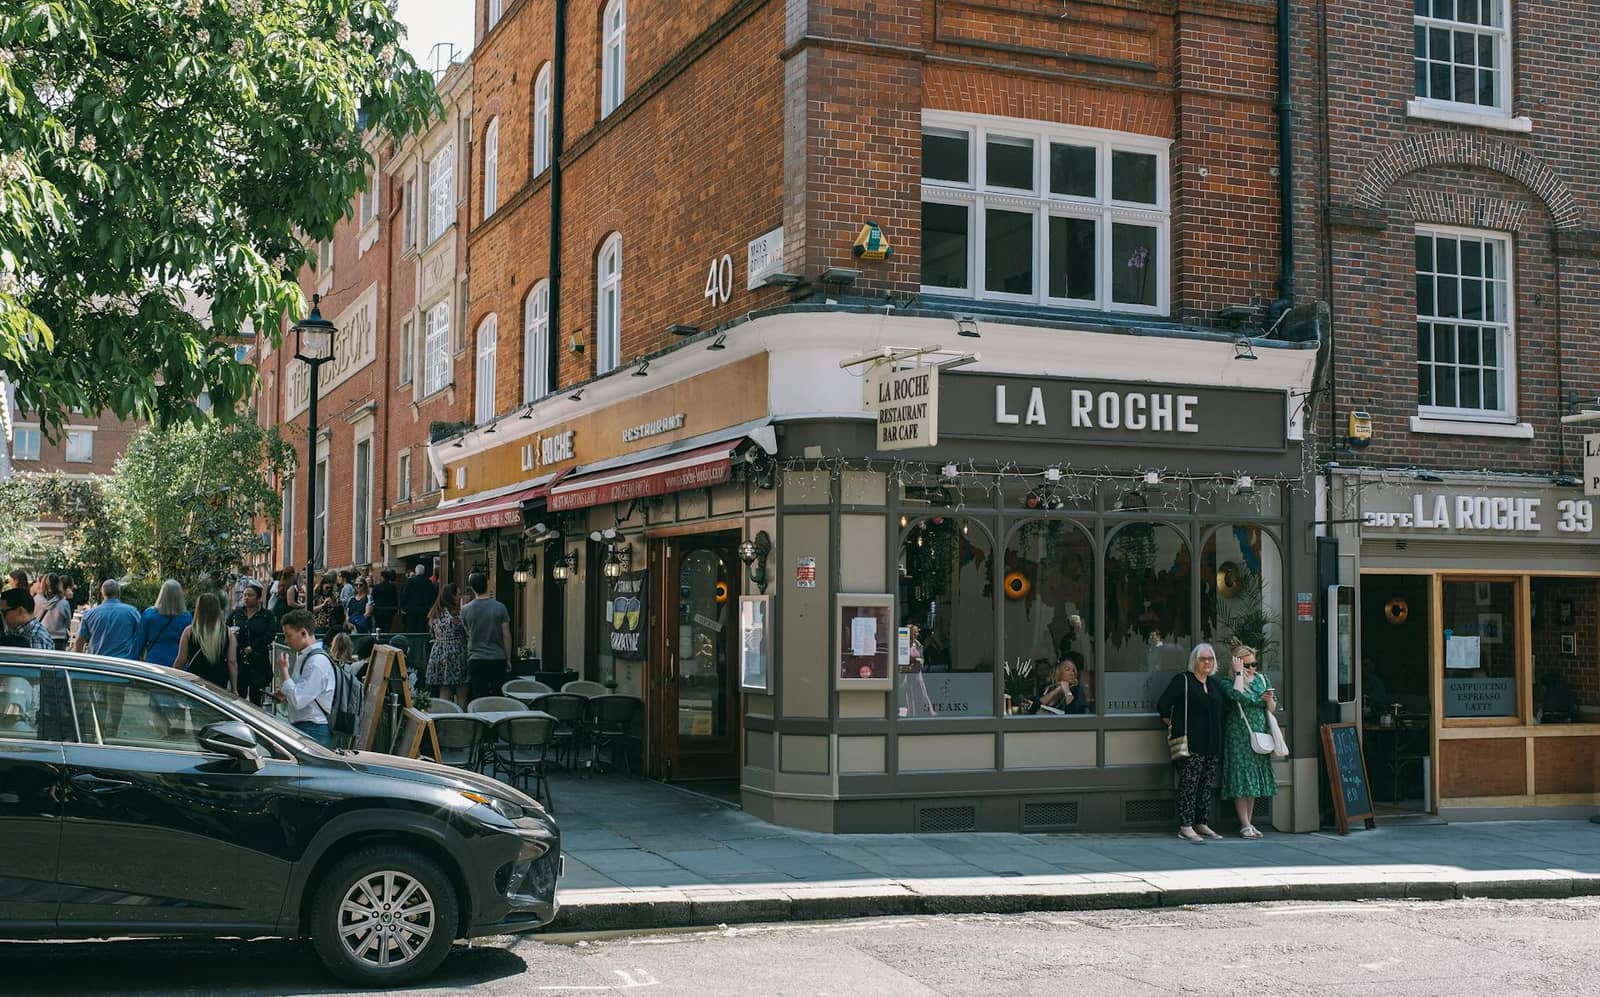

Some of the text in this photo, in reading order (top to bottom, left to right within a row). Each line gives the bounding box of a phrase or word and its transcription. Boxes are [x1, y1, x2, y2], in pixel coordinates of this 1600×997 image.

[704, 253, 733, 308] 40
[878, 373, 929, 402] LA ROCHE
[879, 402, 928, 425] RESTAURANT
[995, 384, 1199, 434] LA ROCHE
[622, 413, 687, 443] RESTAURANT
[882, 423, 918, 443] BAR CAFE
[521, 444, 535, 472] LA
[541, 430, 575, 466] ROCHE
[1363, 494, 1593, 533] CAFE LA ROCHE 39
[1450, 682, 1508, 691] CAPPUCCINO
[1457, 692, 1501, 701] ESPRESSO
[923, 702, 969, 712] STEAKS
[1465, 703, 1493, 711] LATTE
